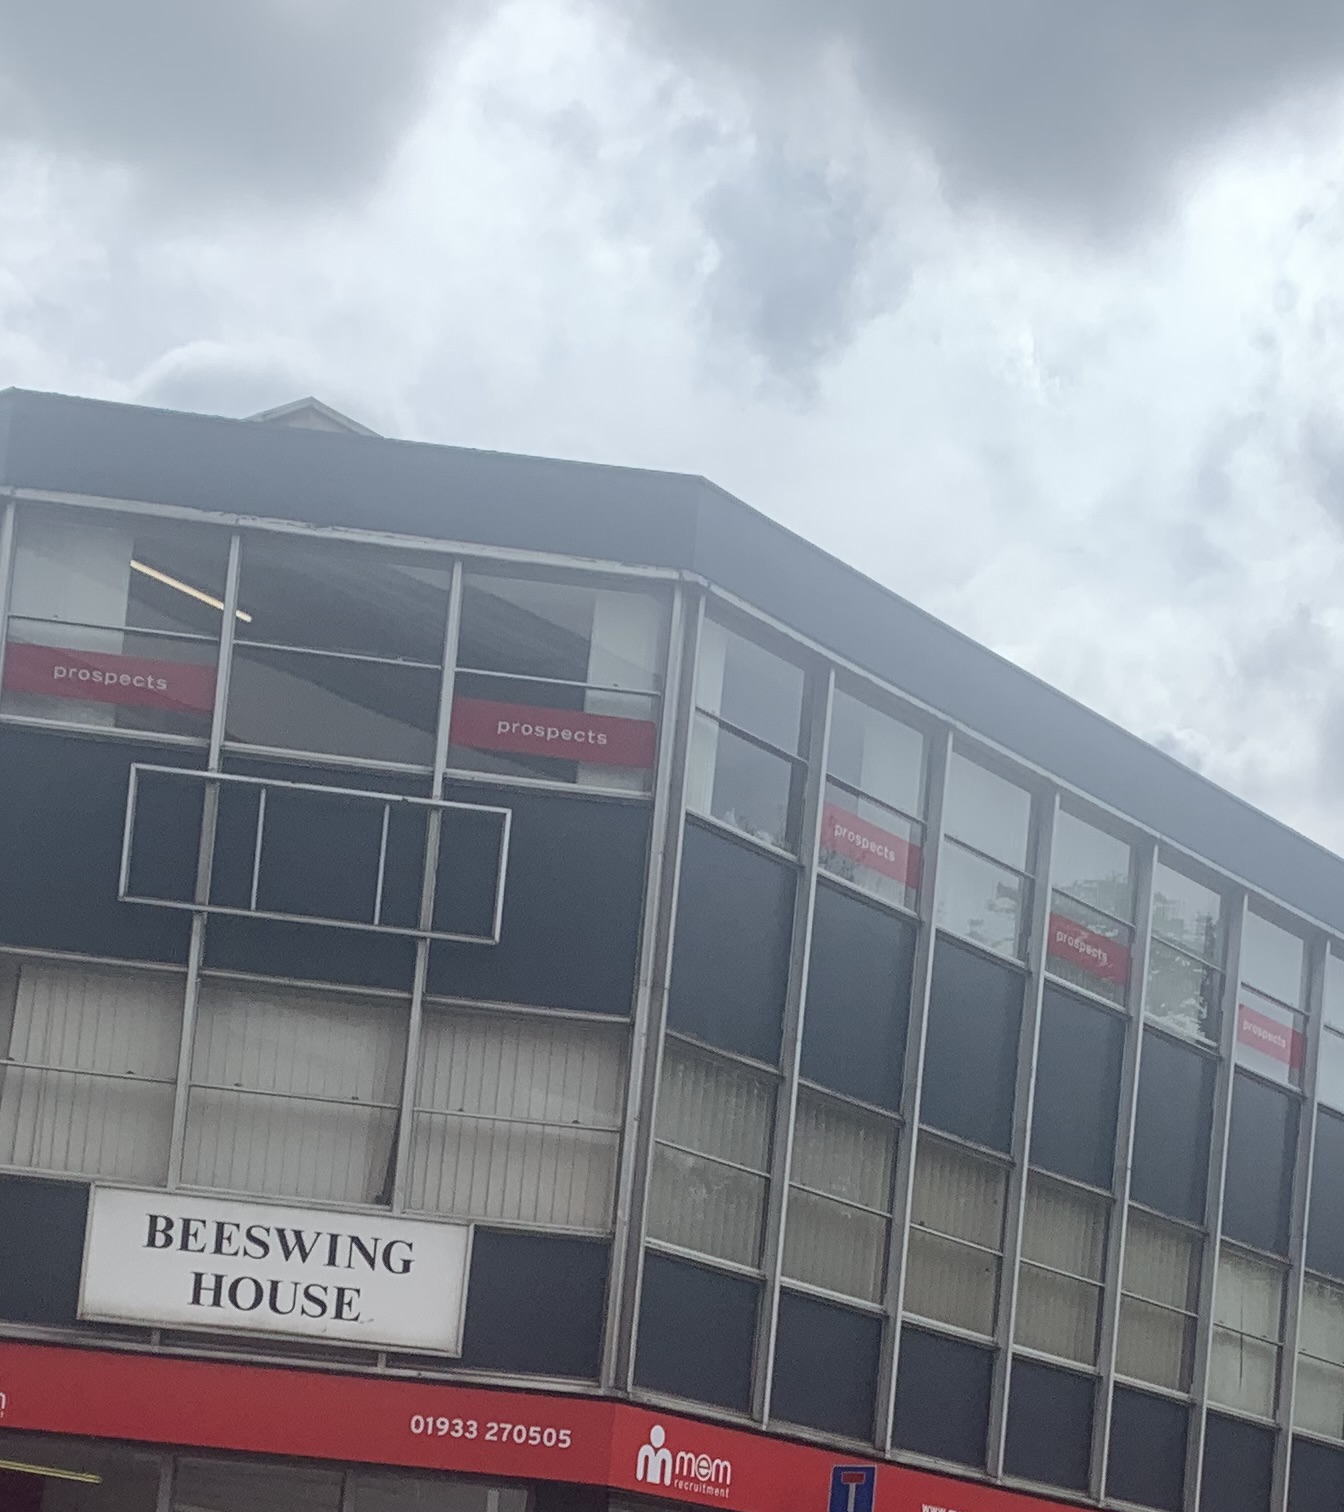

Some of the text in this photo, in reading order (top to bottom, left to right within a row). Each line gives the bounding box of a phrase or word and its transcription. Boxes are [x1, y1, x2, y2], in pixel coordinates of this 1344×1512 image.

[53, 665, 168, 690] prospects
[497, 720, 608, 745] prospects
[833, 822, 896, 863] prospects
[1055, 929, 1108, 963] prospects
[1242, 1019, 1287, 1048] prospects
[142, 1213, 416, 1275] BEESWING
[187, 1271, 362, 1323] HOUSE
[410, 1414, 572, 1449] 01933 270505
[674, 1450, 732, 1486] mem
[673, 1478, 730, 1498] recruitment
